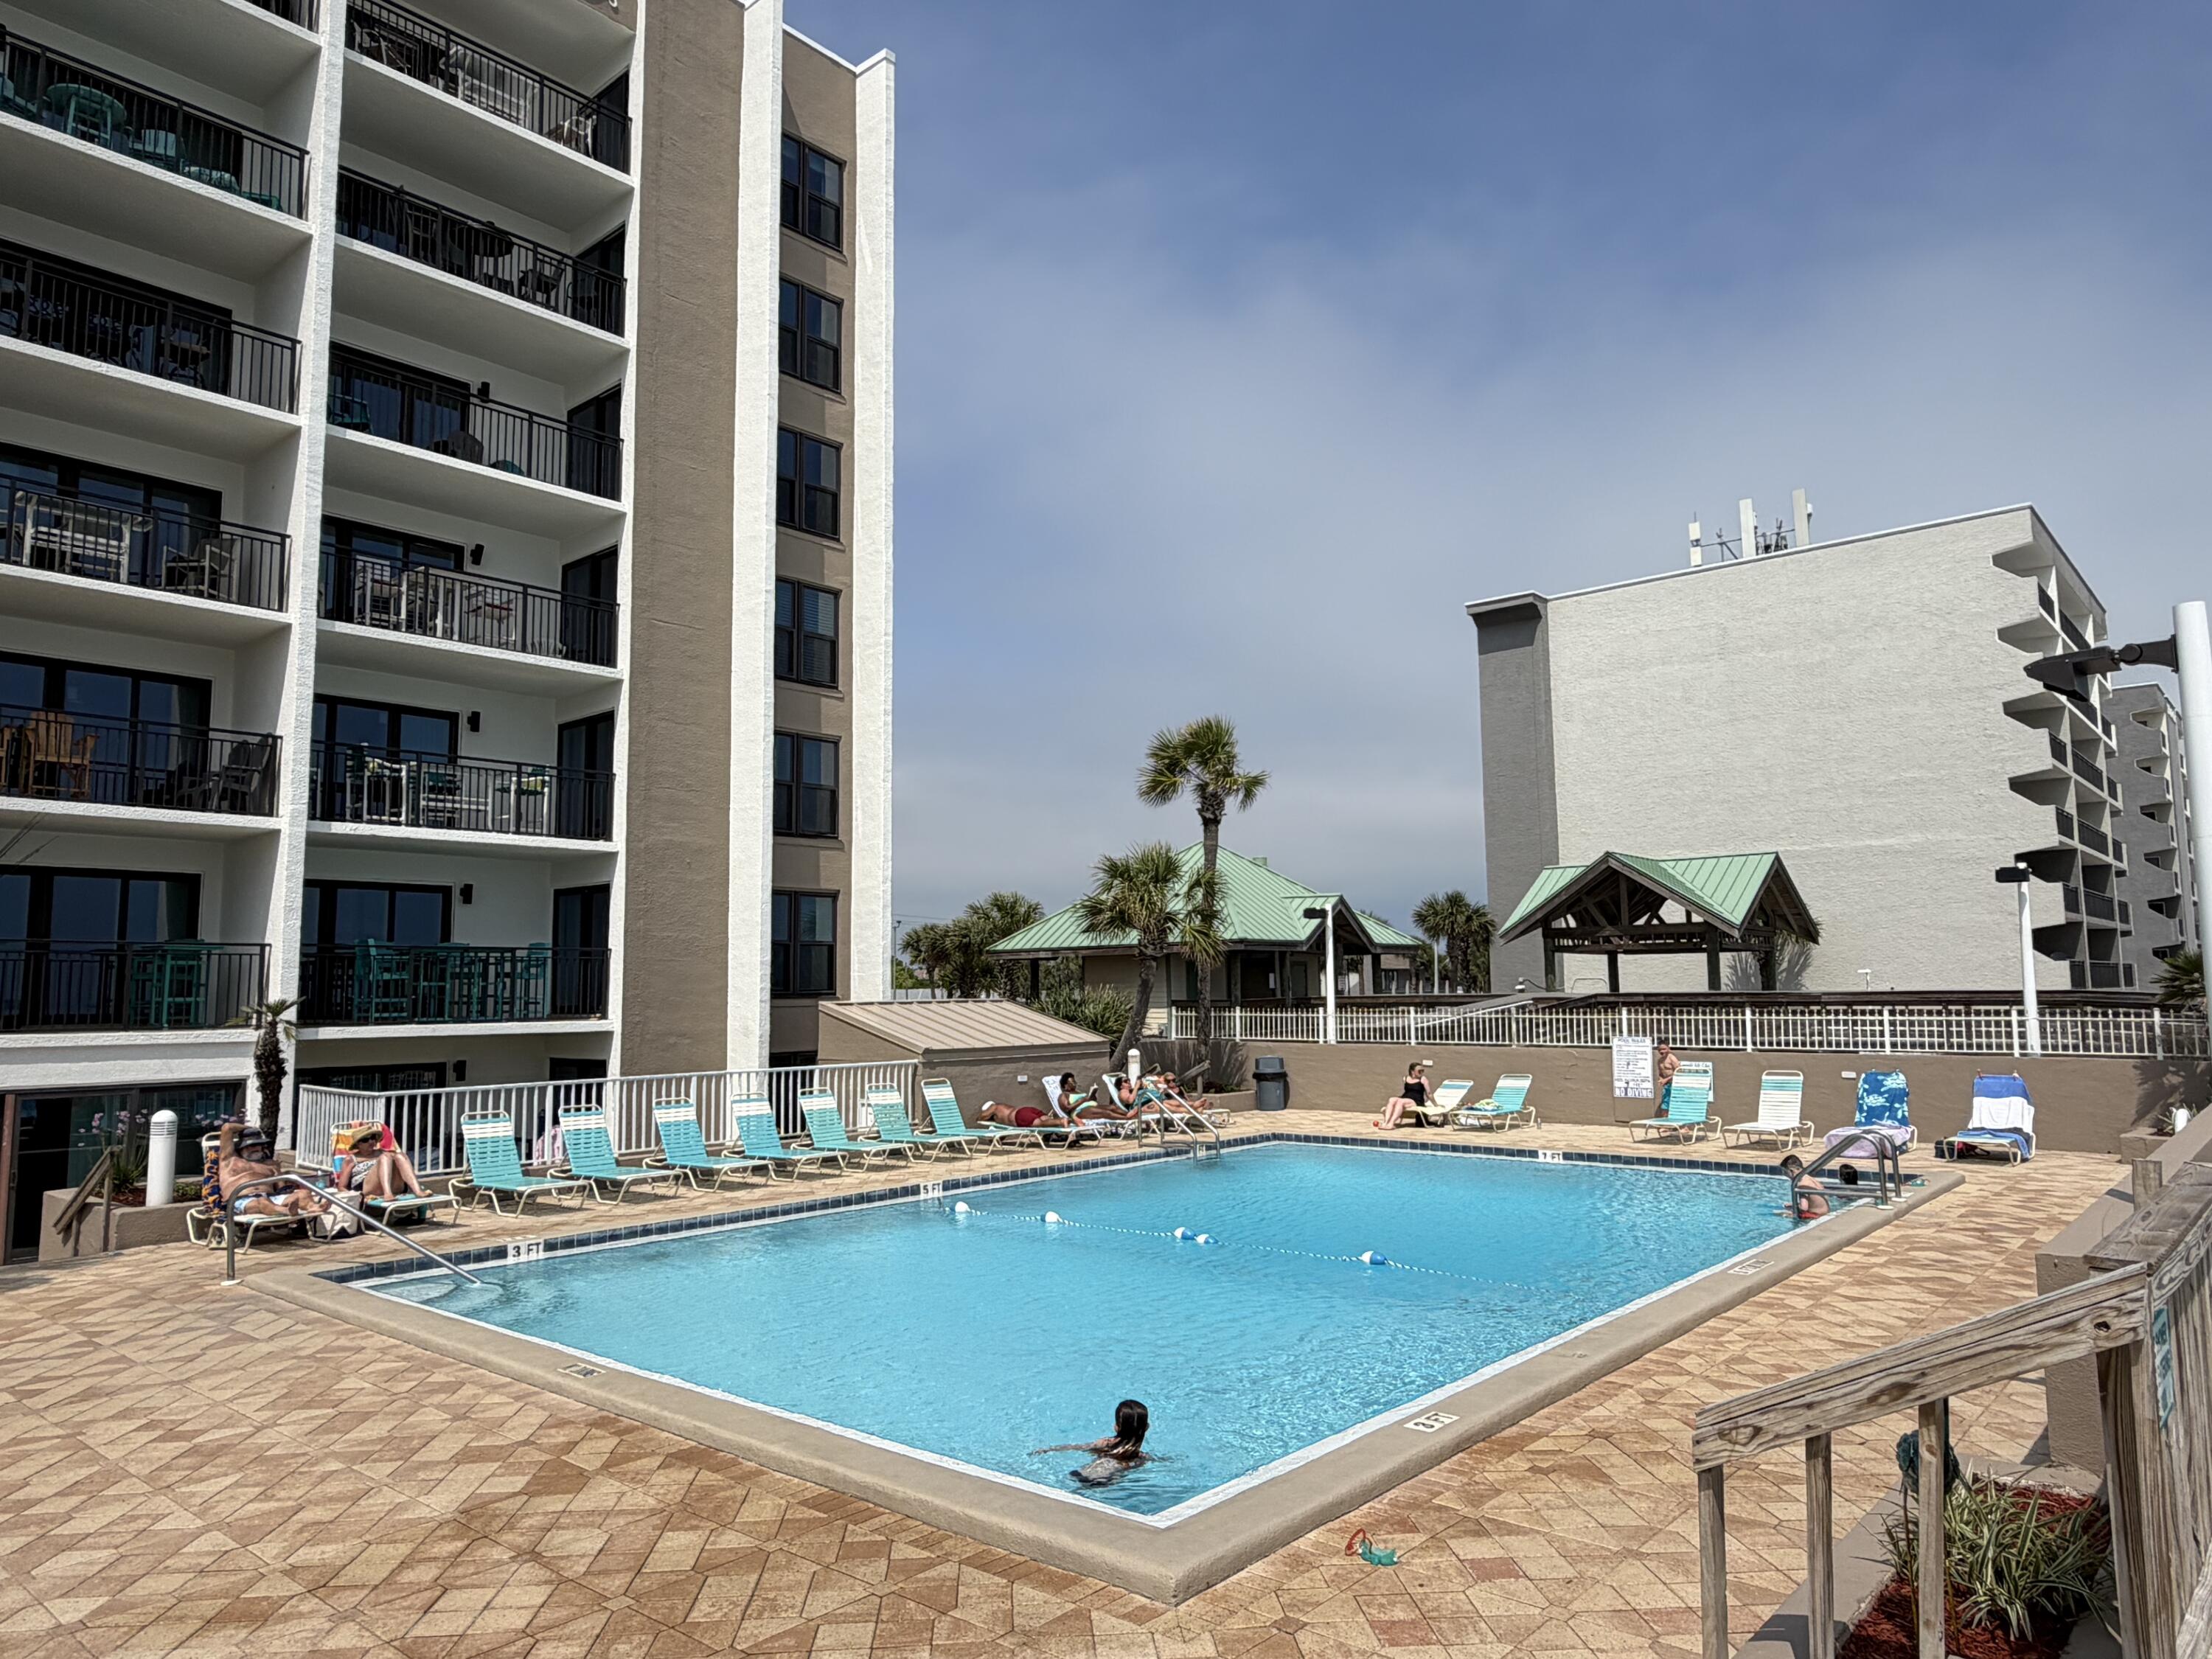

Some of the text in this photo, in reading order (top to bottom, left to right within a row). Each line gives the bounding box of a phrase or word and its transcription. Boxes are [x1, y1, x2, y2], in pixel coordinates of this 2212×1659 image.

[1615, 1088, 1653, 1097] NO DIVING
[1542, 1152, 1561, 1161] 7 FT
[922, 1183, 941, 1194] 5 FT
[512, 1242, 541, 1257] 3 FT
[1424, 1413, 1453, 1424] FT
